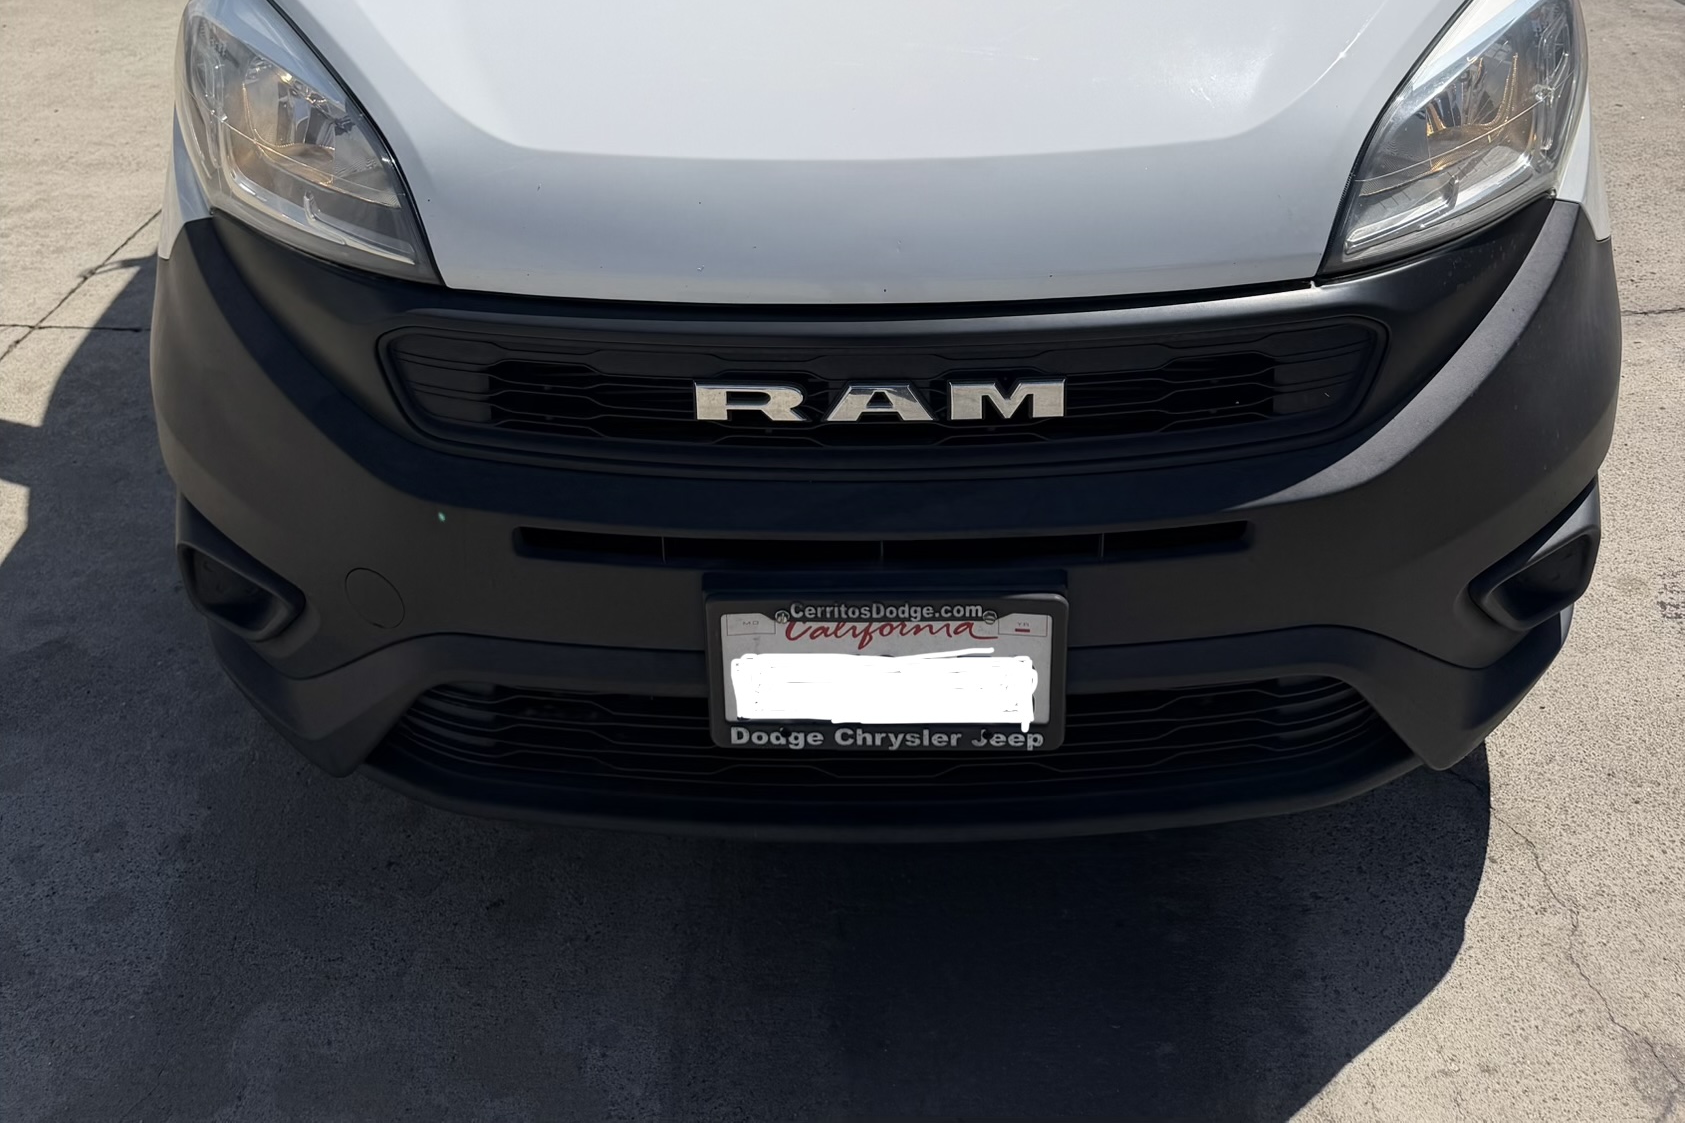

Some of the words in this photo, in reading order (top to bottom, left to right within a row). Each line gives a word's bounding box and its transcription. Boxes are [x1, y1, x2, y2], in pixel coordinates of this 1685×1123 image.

[693, 378, 1067, 422] RAM
[790, 603, 983, 621] CerritosDodge.com
[785, 621, 998, 650] California
[730, 726, 825, 749] Dodge
[834, 727, 962, 751] Chrysler
[971, 729, 1044, 751] Jeep
